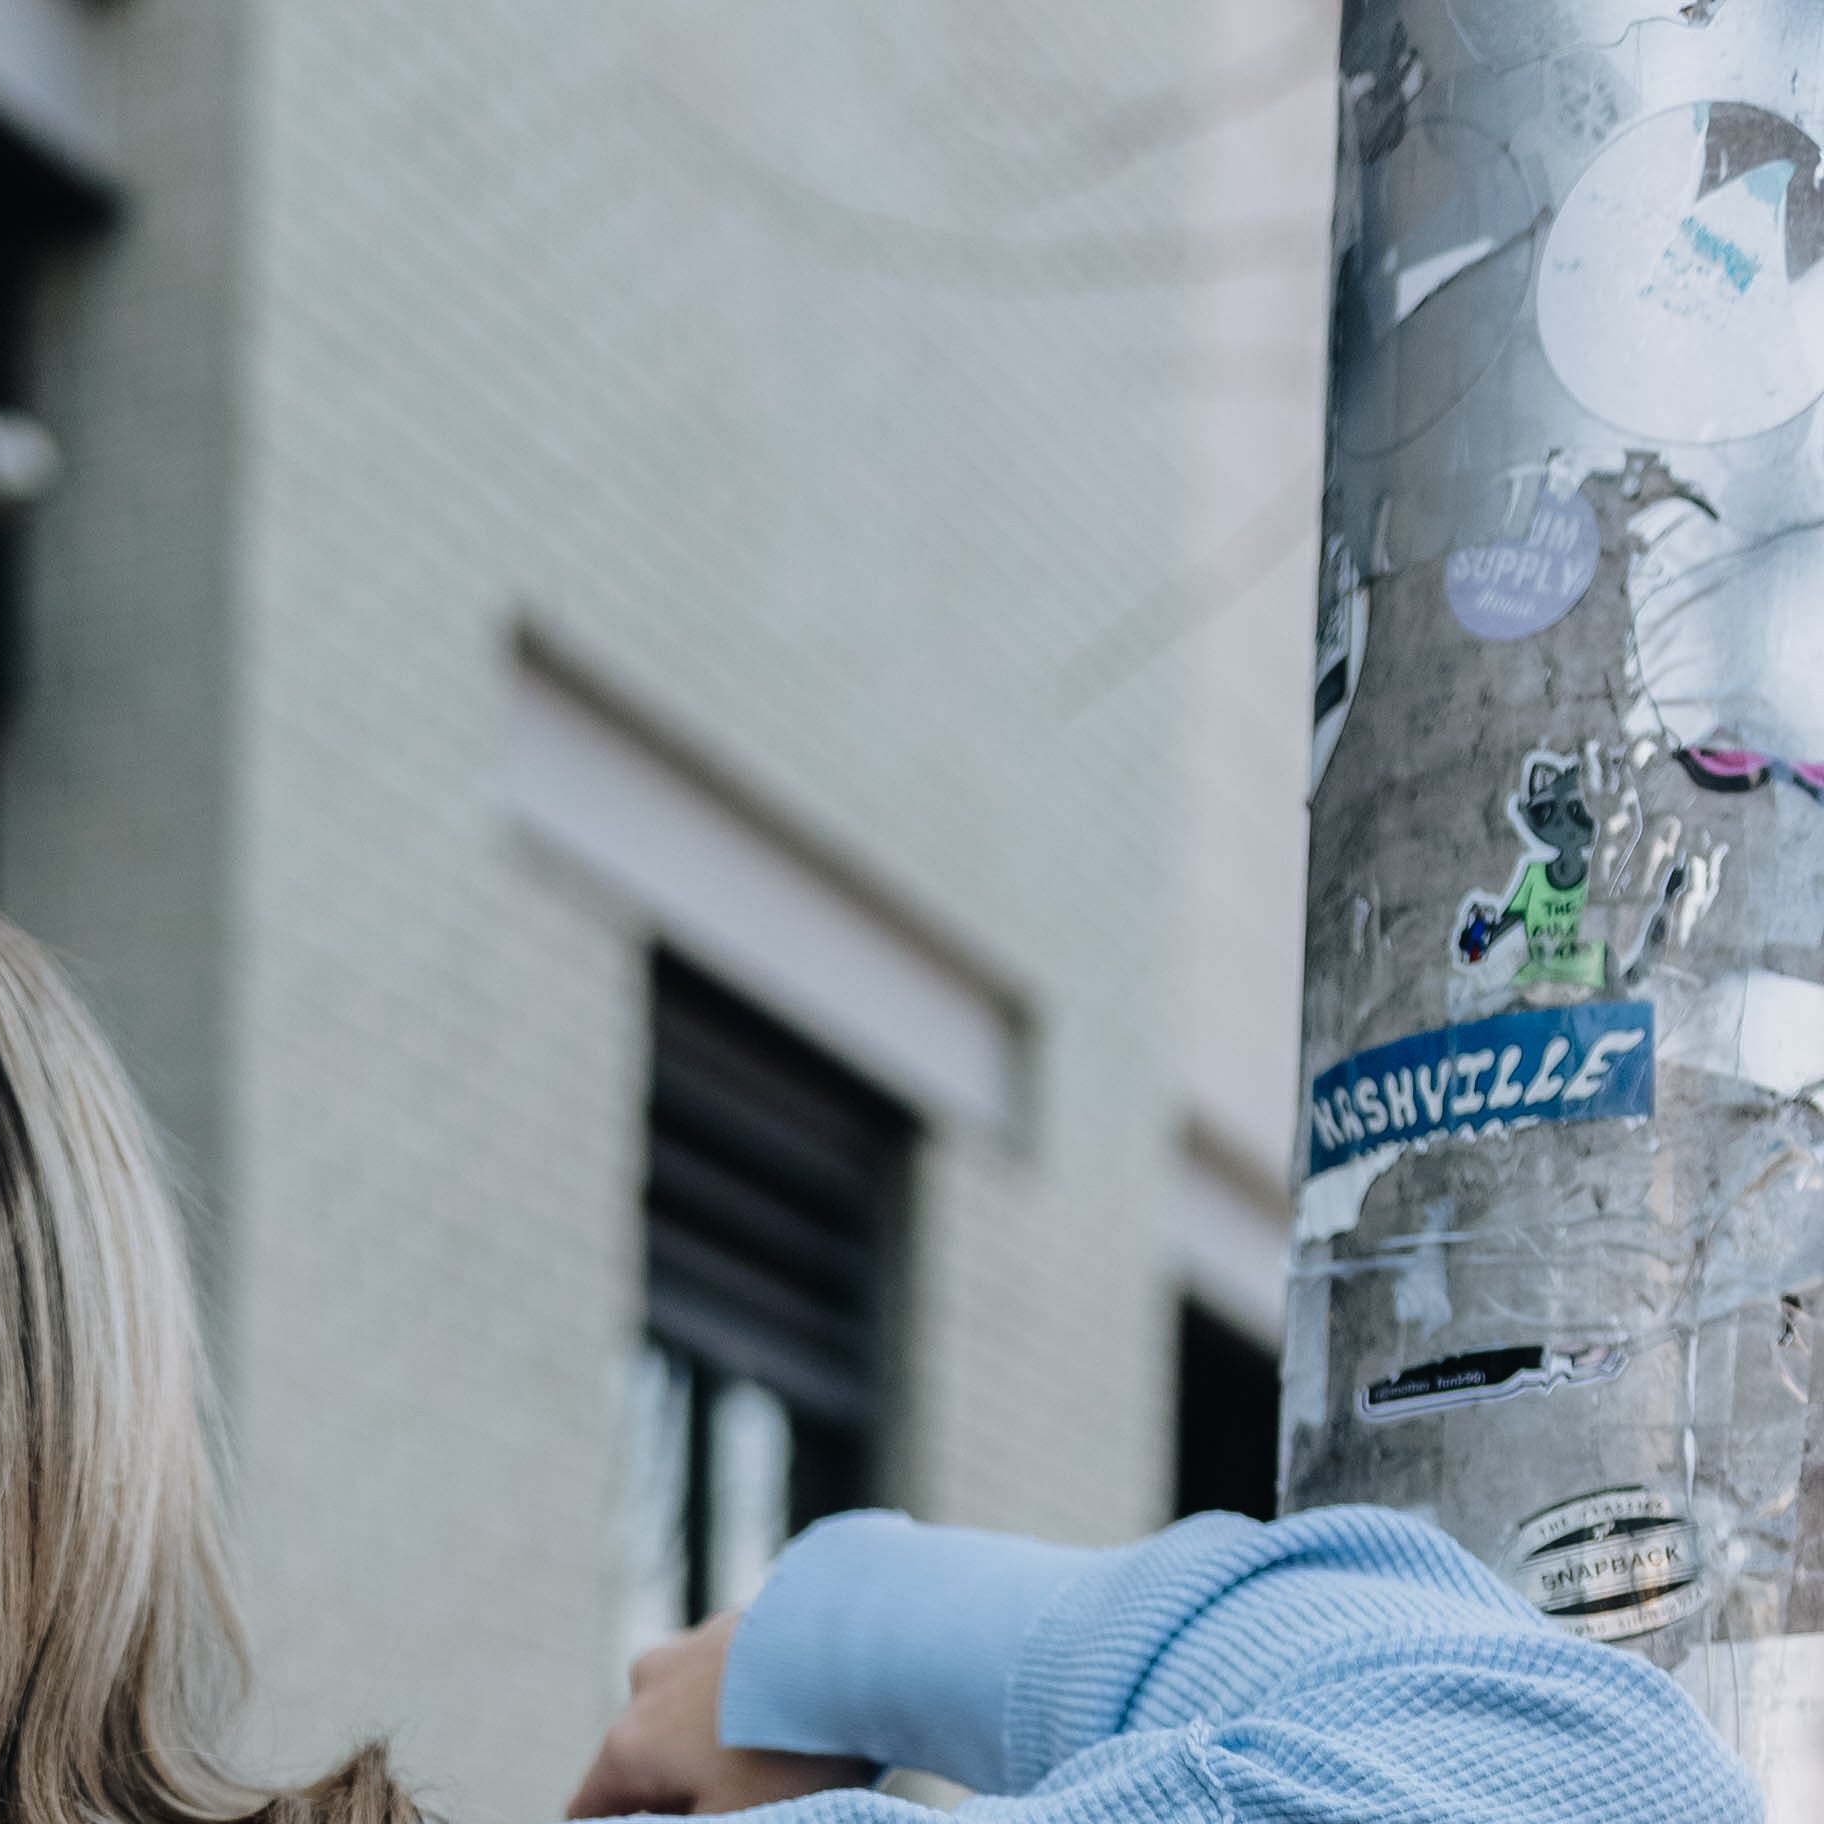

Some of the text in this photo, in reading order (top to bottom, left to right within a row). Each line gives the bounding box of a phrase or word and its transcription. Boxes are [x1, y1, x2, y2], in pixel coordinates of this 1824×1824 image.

[1453, 549, 1596, 597] SUPPLY
[1313, 1028, 1646, 1150] NASHVILLE
[1541, 1545, 1680, 1591] SNAPBACK
